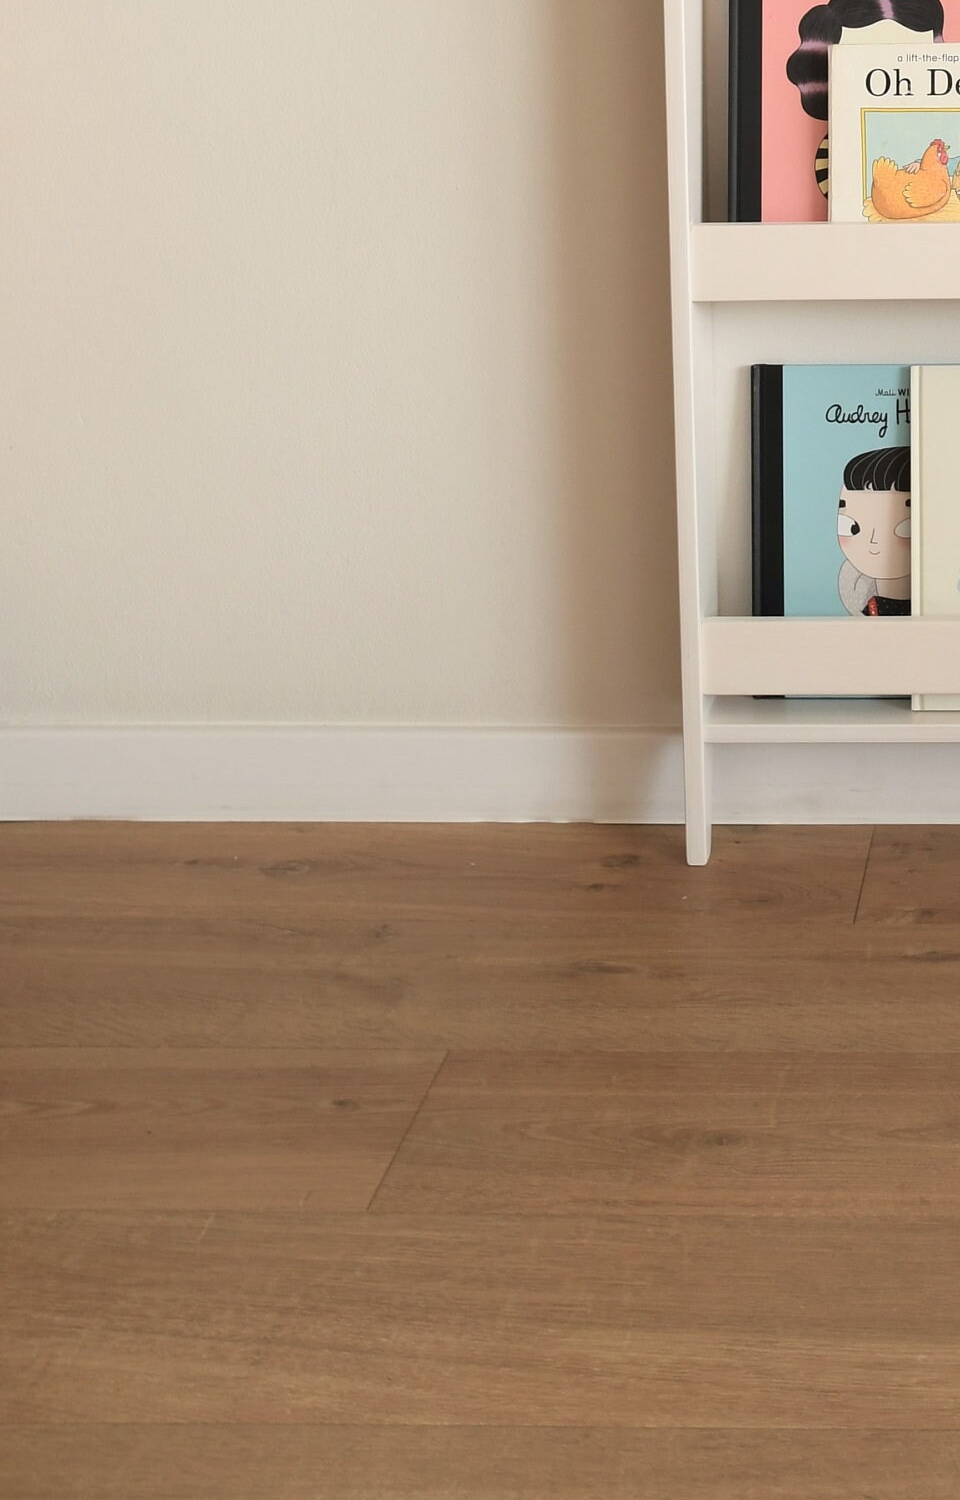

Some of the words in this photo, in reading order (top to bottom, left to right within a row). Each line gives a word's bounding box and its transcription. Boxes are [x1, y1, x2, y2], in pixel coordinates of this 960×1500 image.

[906, 53, 959, 64] lift-the-flap
[865, 68, 914, 97] Oh
[875, 388, 896, 396] Mali
[897, 388, 910, 396] WI
[825, 404, 888, 438] Audrey
[896, 398, 911, 425] H
